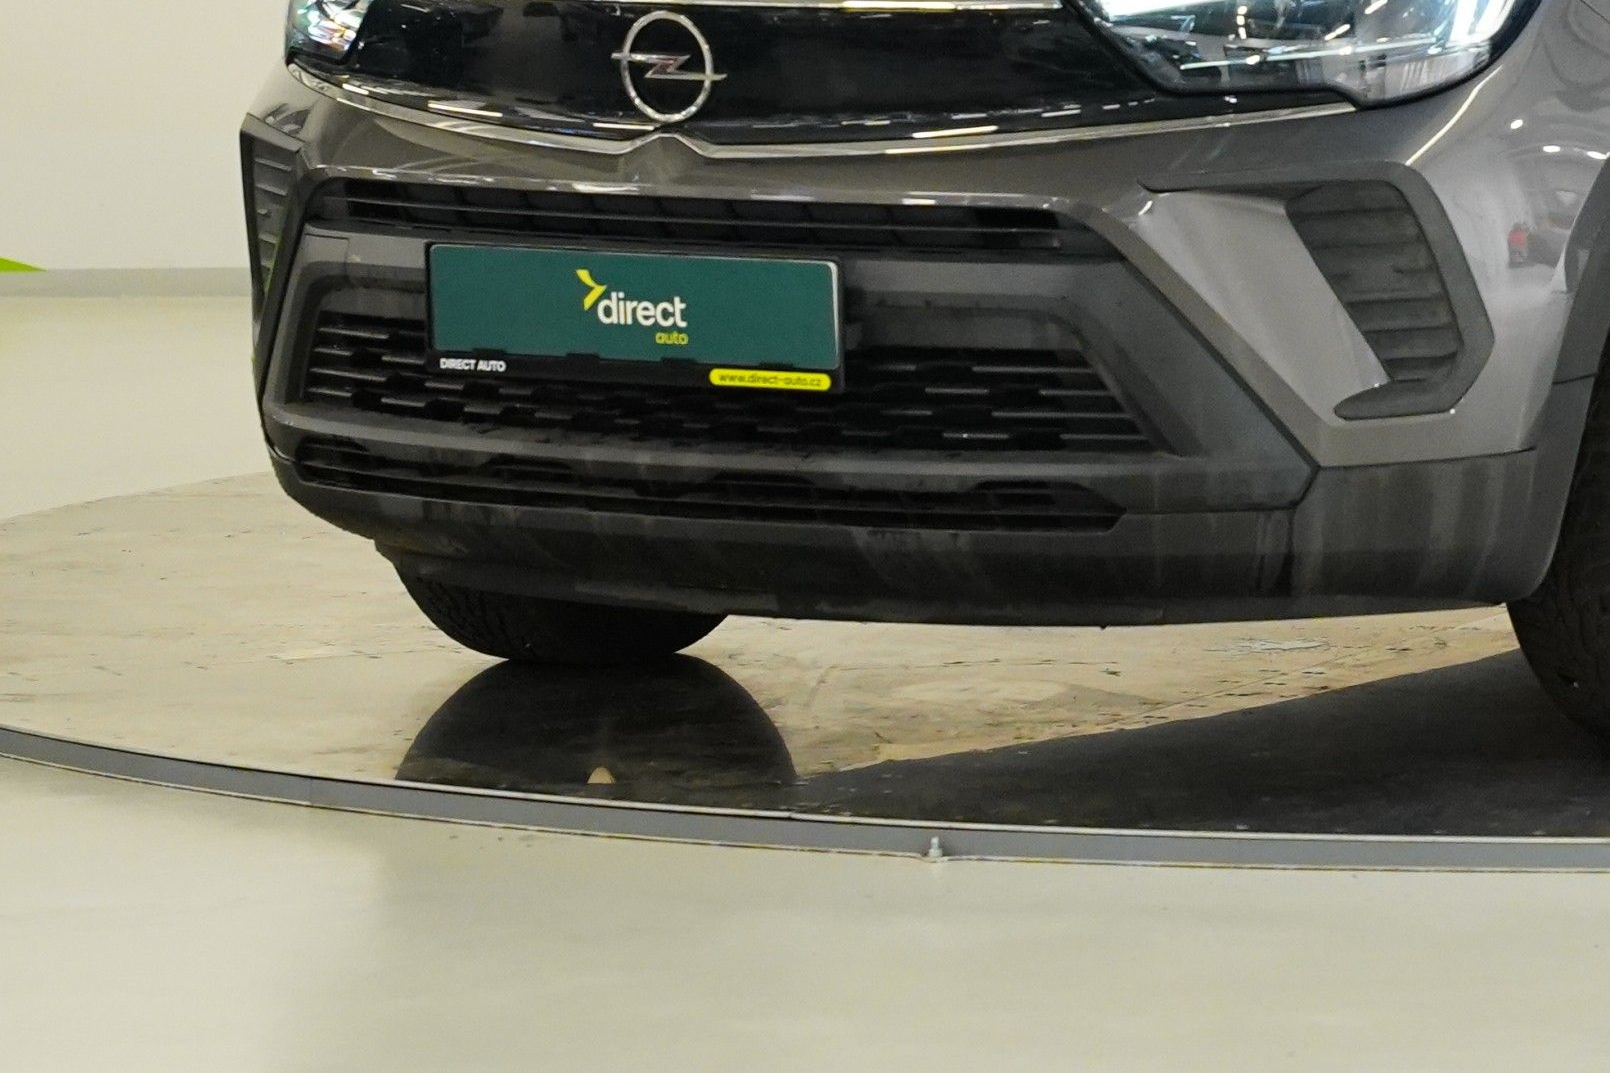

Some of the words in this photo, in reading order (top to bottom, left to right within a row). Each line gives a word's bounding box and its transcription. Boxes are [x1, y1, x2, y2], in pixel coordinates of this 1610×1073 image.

[597, 291, 688, 327] direct
[655, 331, 689, 345] auto
[439, 358, 477, 370] DIRECT
[476, 359, 507, 372] AUTO
[718, 372, 823, 387] www.direct-auto.cz
